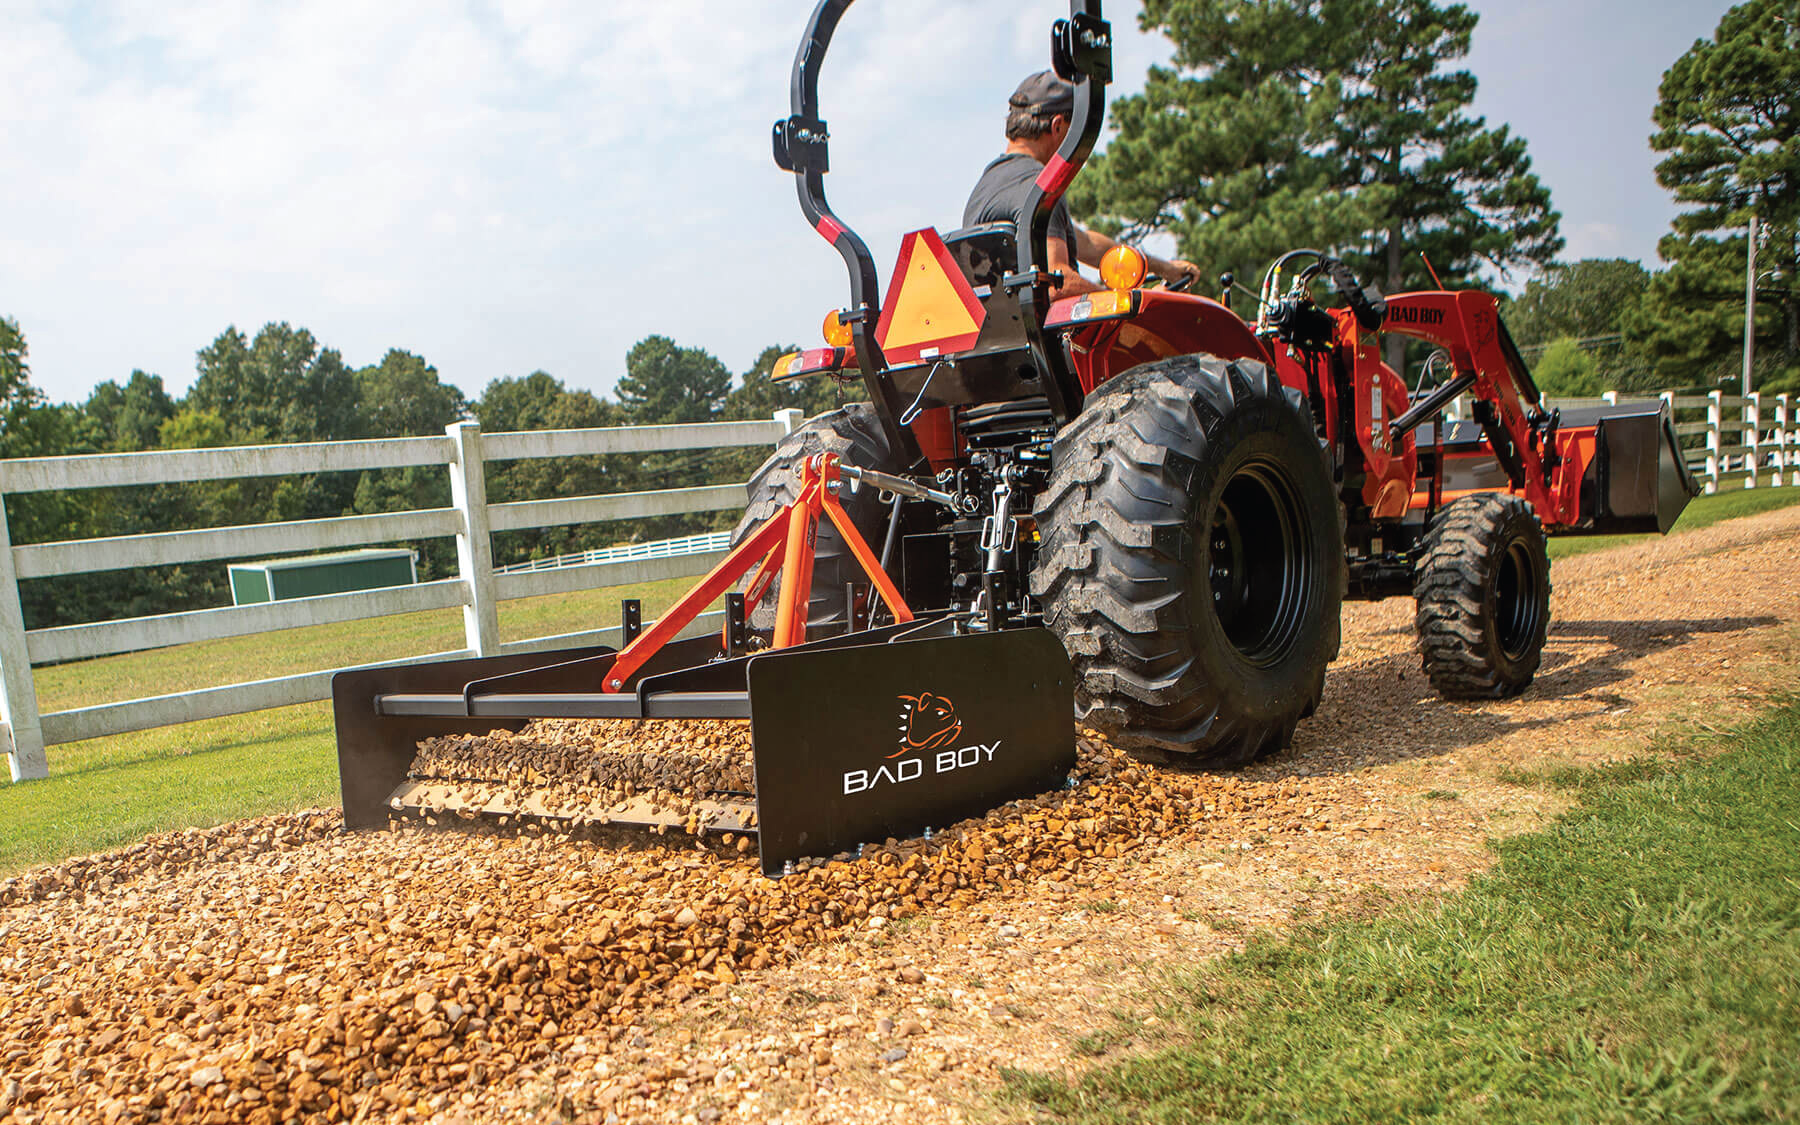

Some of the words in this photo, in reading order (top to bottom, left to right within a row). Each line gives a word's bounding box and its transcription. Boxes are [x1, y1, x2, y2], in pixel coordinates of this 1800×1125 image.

[1390, 306, 1418, 322] BAD
[1420, 307, 1445, 324] BOY
[844, 758, 923, 794] BAD
[936, 740, 1001, 773] BOY
